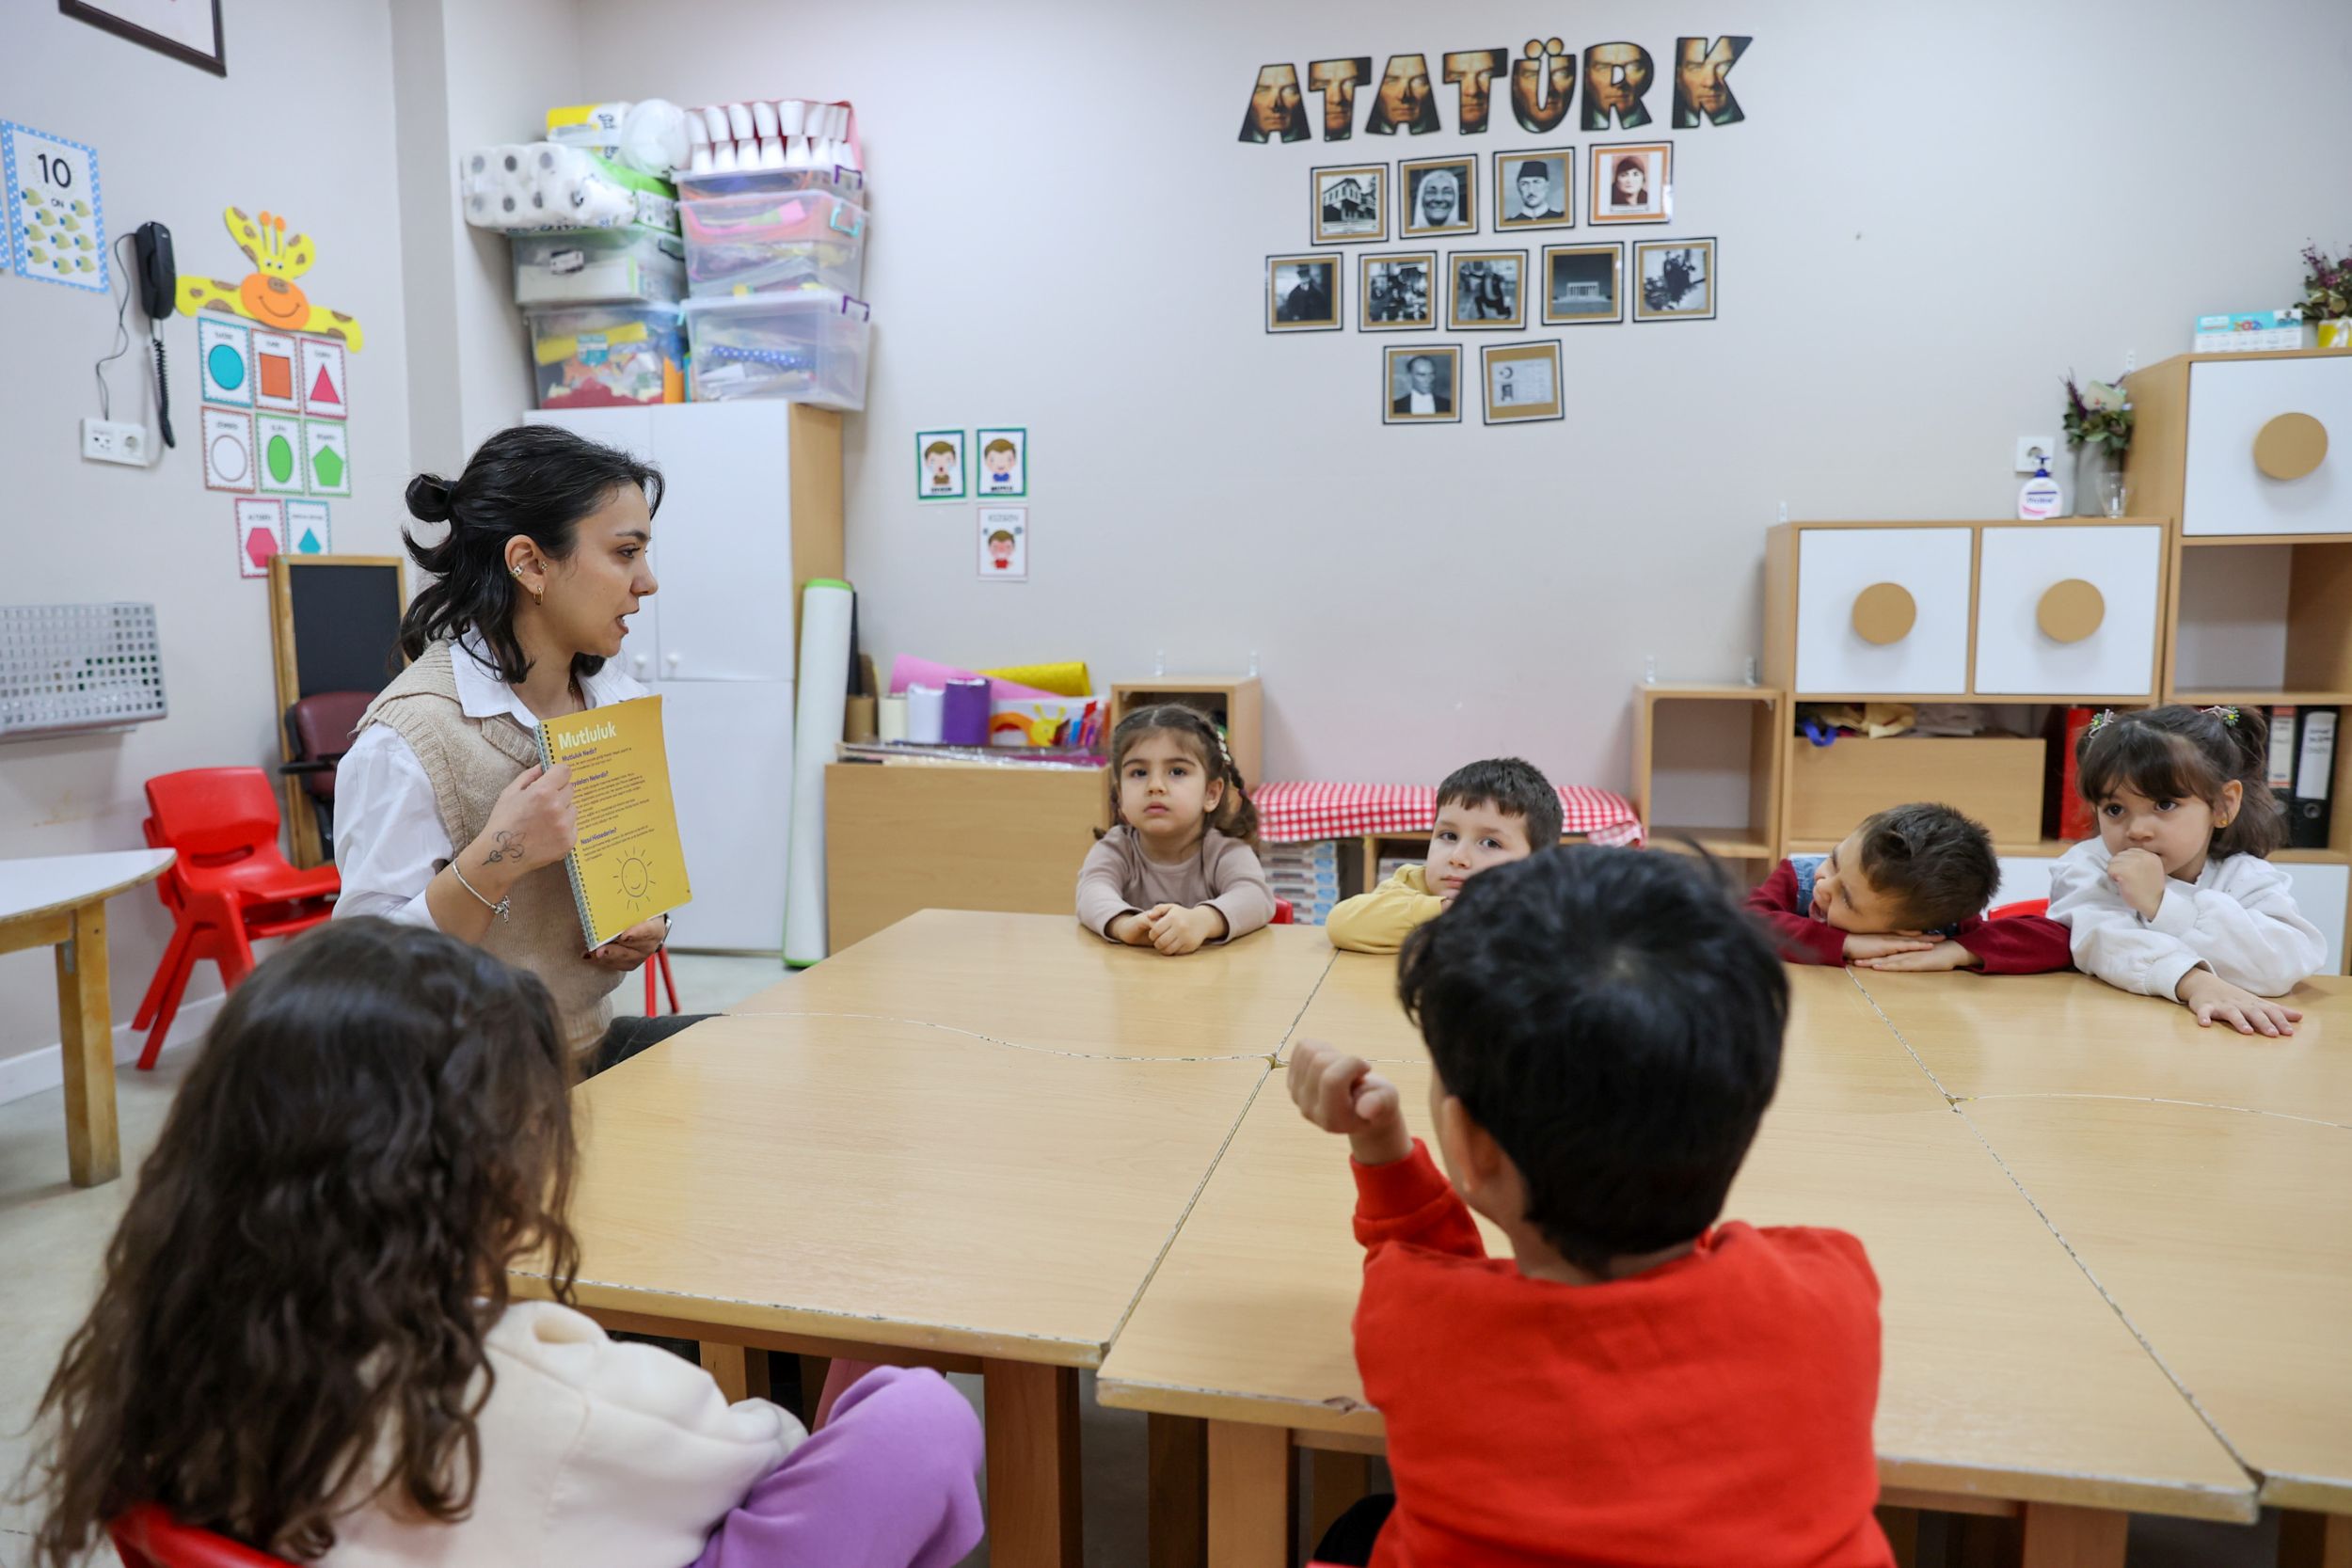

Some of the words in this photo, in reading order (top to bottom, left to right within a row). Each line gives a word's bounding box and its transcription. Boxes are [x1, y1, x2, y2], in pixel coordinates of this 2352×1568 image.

[1238, 36, 1753, 144] ATATÜRK
[38, 153, 72, 188] 10
[51, 198, 65, 209] ON
[558, 721, 616, 750] Mutluluk
[562, 752, 582, 762] Mutluluk
